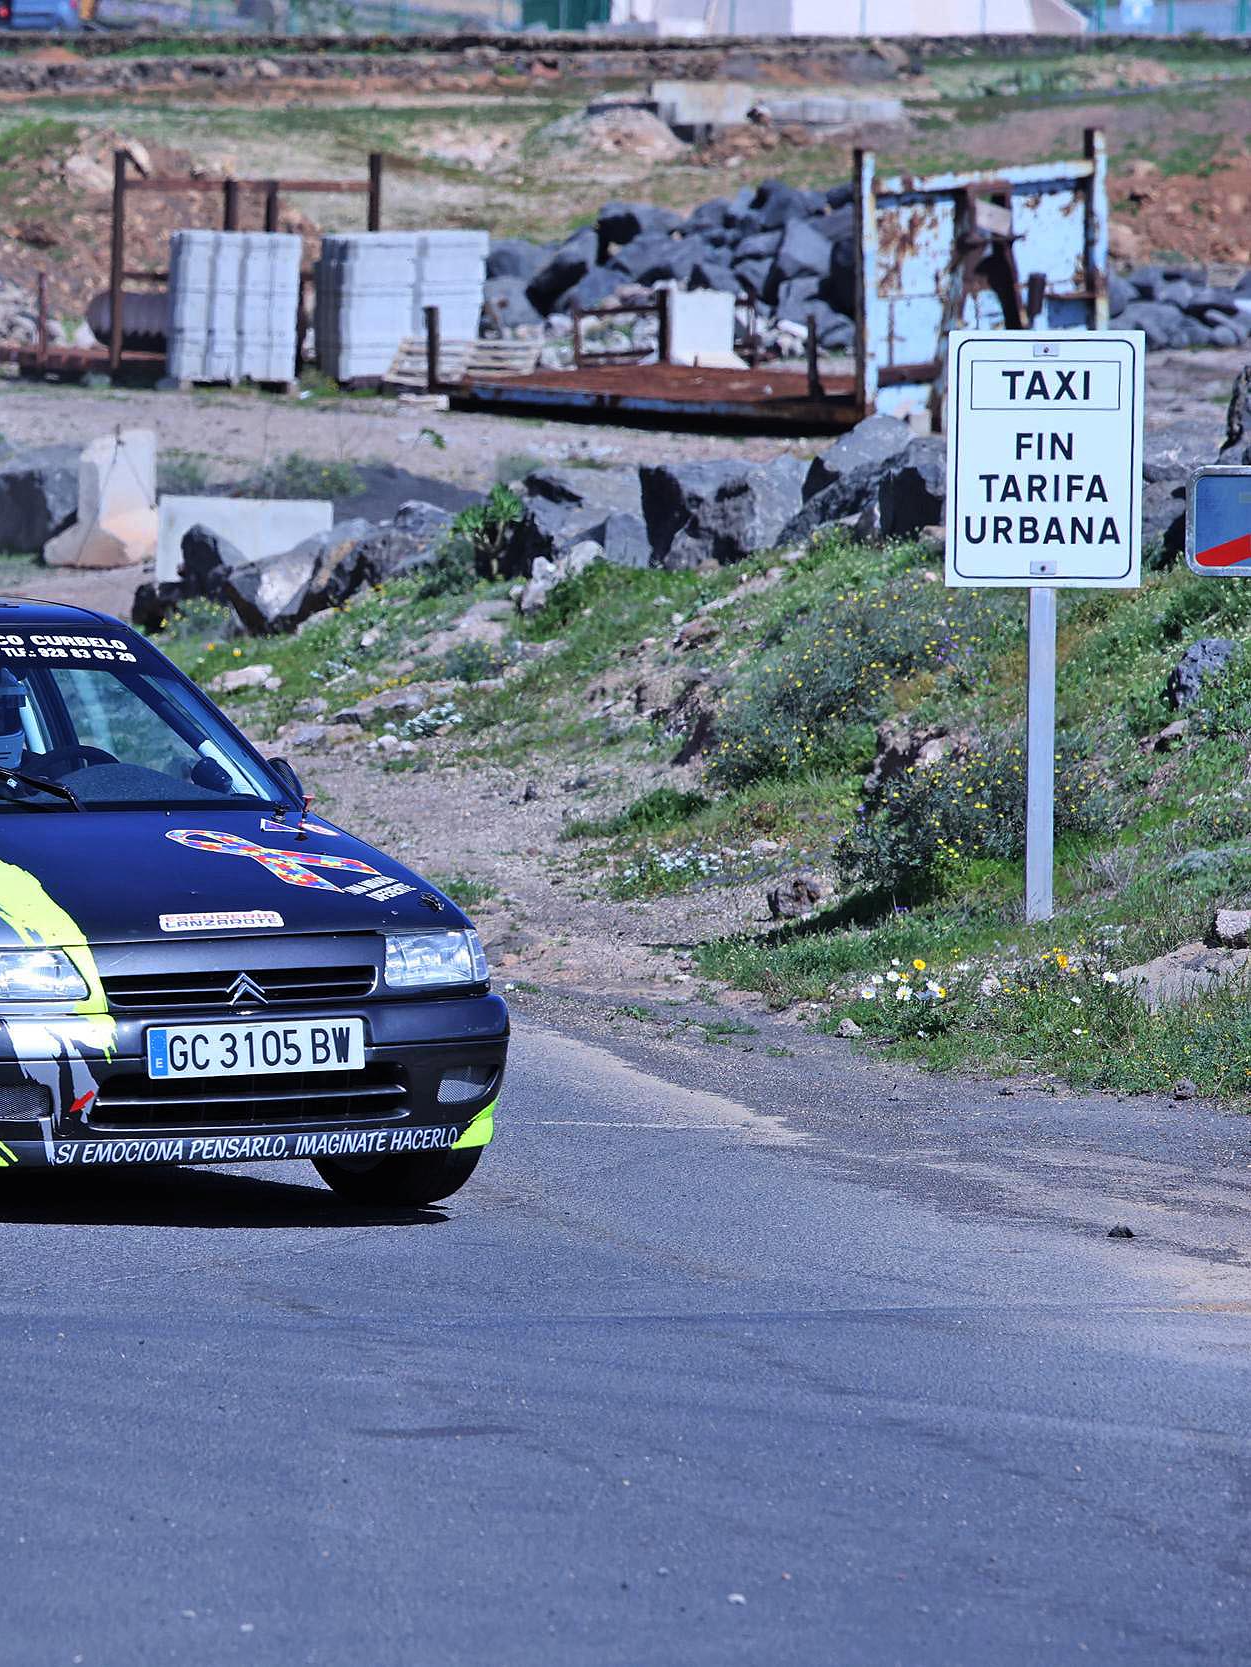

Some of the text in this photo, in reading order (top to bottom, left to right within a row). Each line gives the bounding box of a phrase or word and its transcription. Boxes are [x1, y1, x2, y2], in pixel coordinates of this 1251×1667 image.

[1002, 370, 1091, 401] TAXI
[1015, 432, 1074, 461] FIN
[978, 474, 1109, 503] TARIFA
[964, 515, 1121, 545] URBANA
[29, 635, 128, 650] CURBELO
[37, 647, 69, 659] 928
[69, 648, 92, 659] 83
[92, 649, 115, 661] 63
[115, 651, 138, 663] 20
[165, 918, 279, 928] LANZAROTE
[154, 1026, 351, 1072] E GC 3105 BW
[55, 1126, 458, 1164] SI EMOCIONA PENSARLO, IMAGINATE HACERLO
